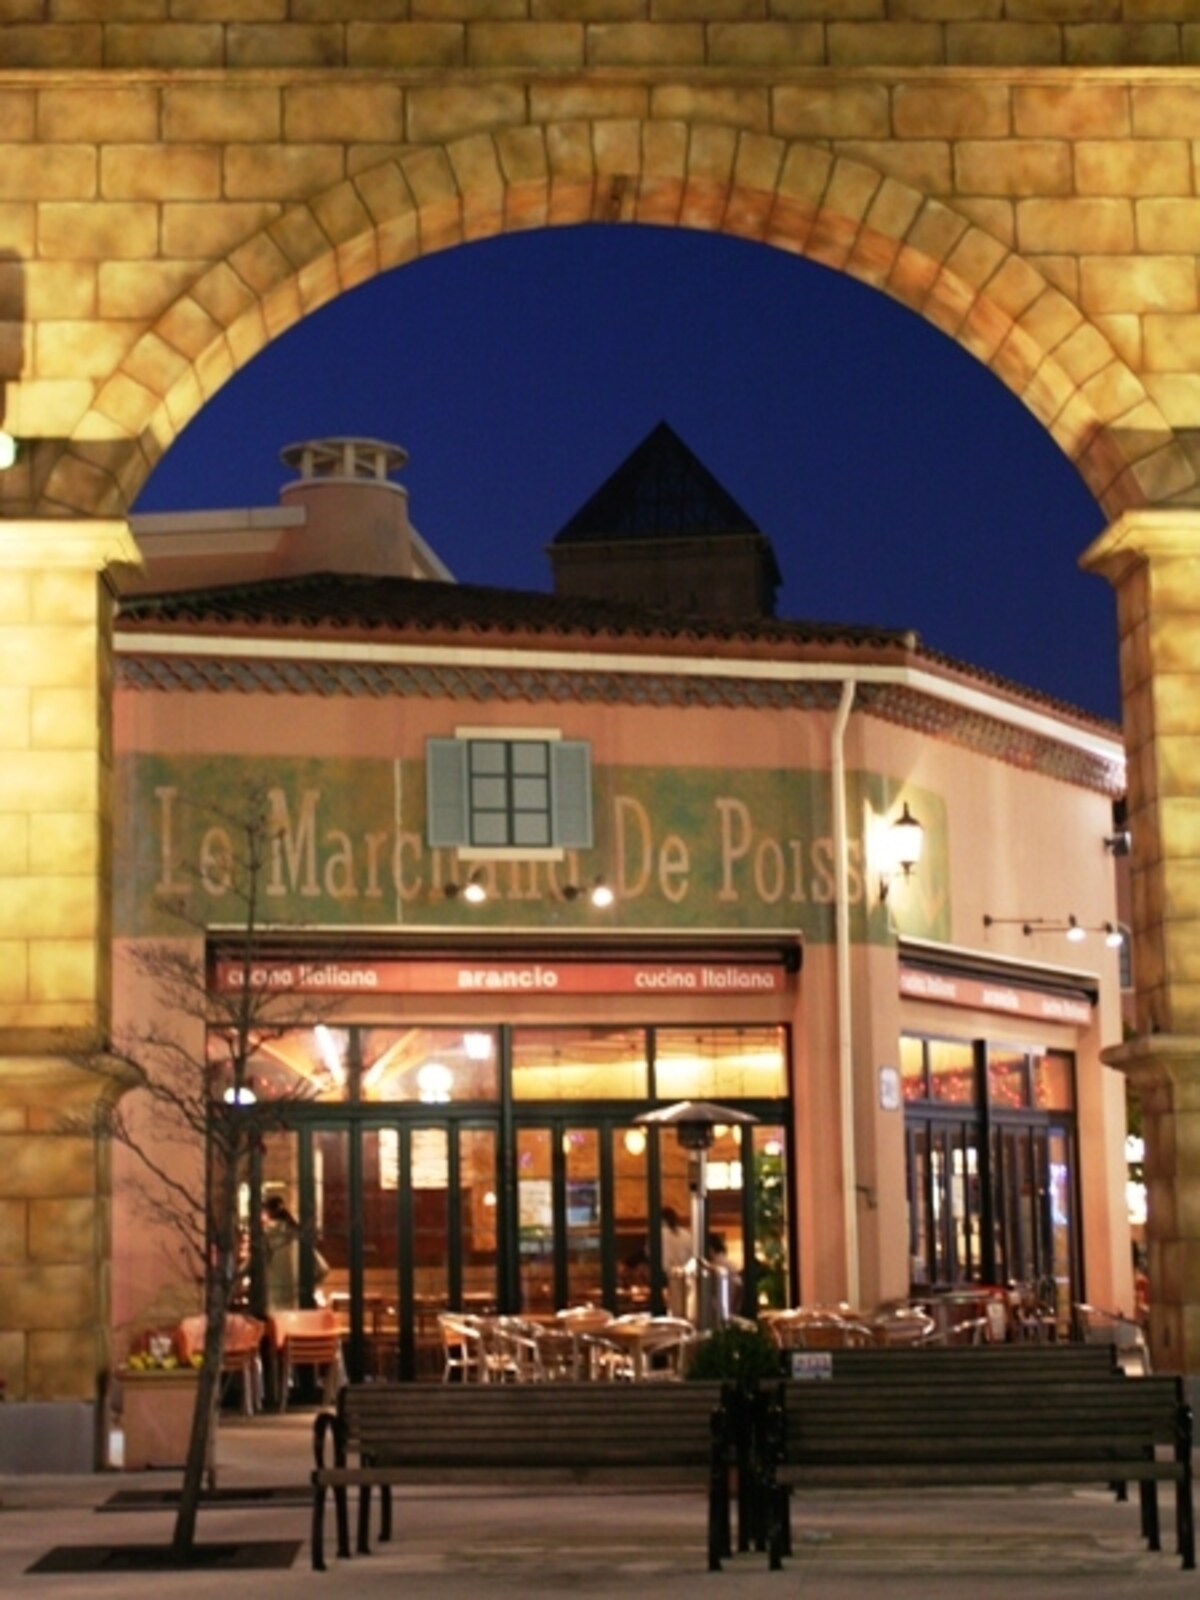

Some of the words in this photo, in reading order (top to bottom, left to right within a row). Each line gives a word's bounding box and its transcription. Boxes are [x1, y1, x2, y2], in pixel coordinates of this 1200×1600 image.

[154, 785, 234, 896] Le
[614, 795, 690, 902] De
[457, 966, 558, 988] arancio
[634, 968, 697, 989] cucina
[701, 967, 775, 989] Italiana
